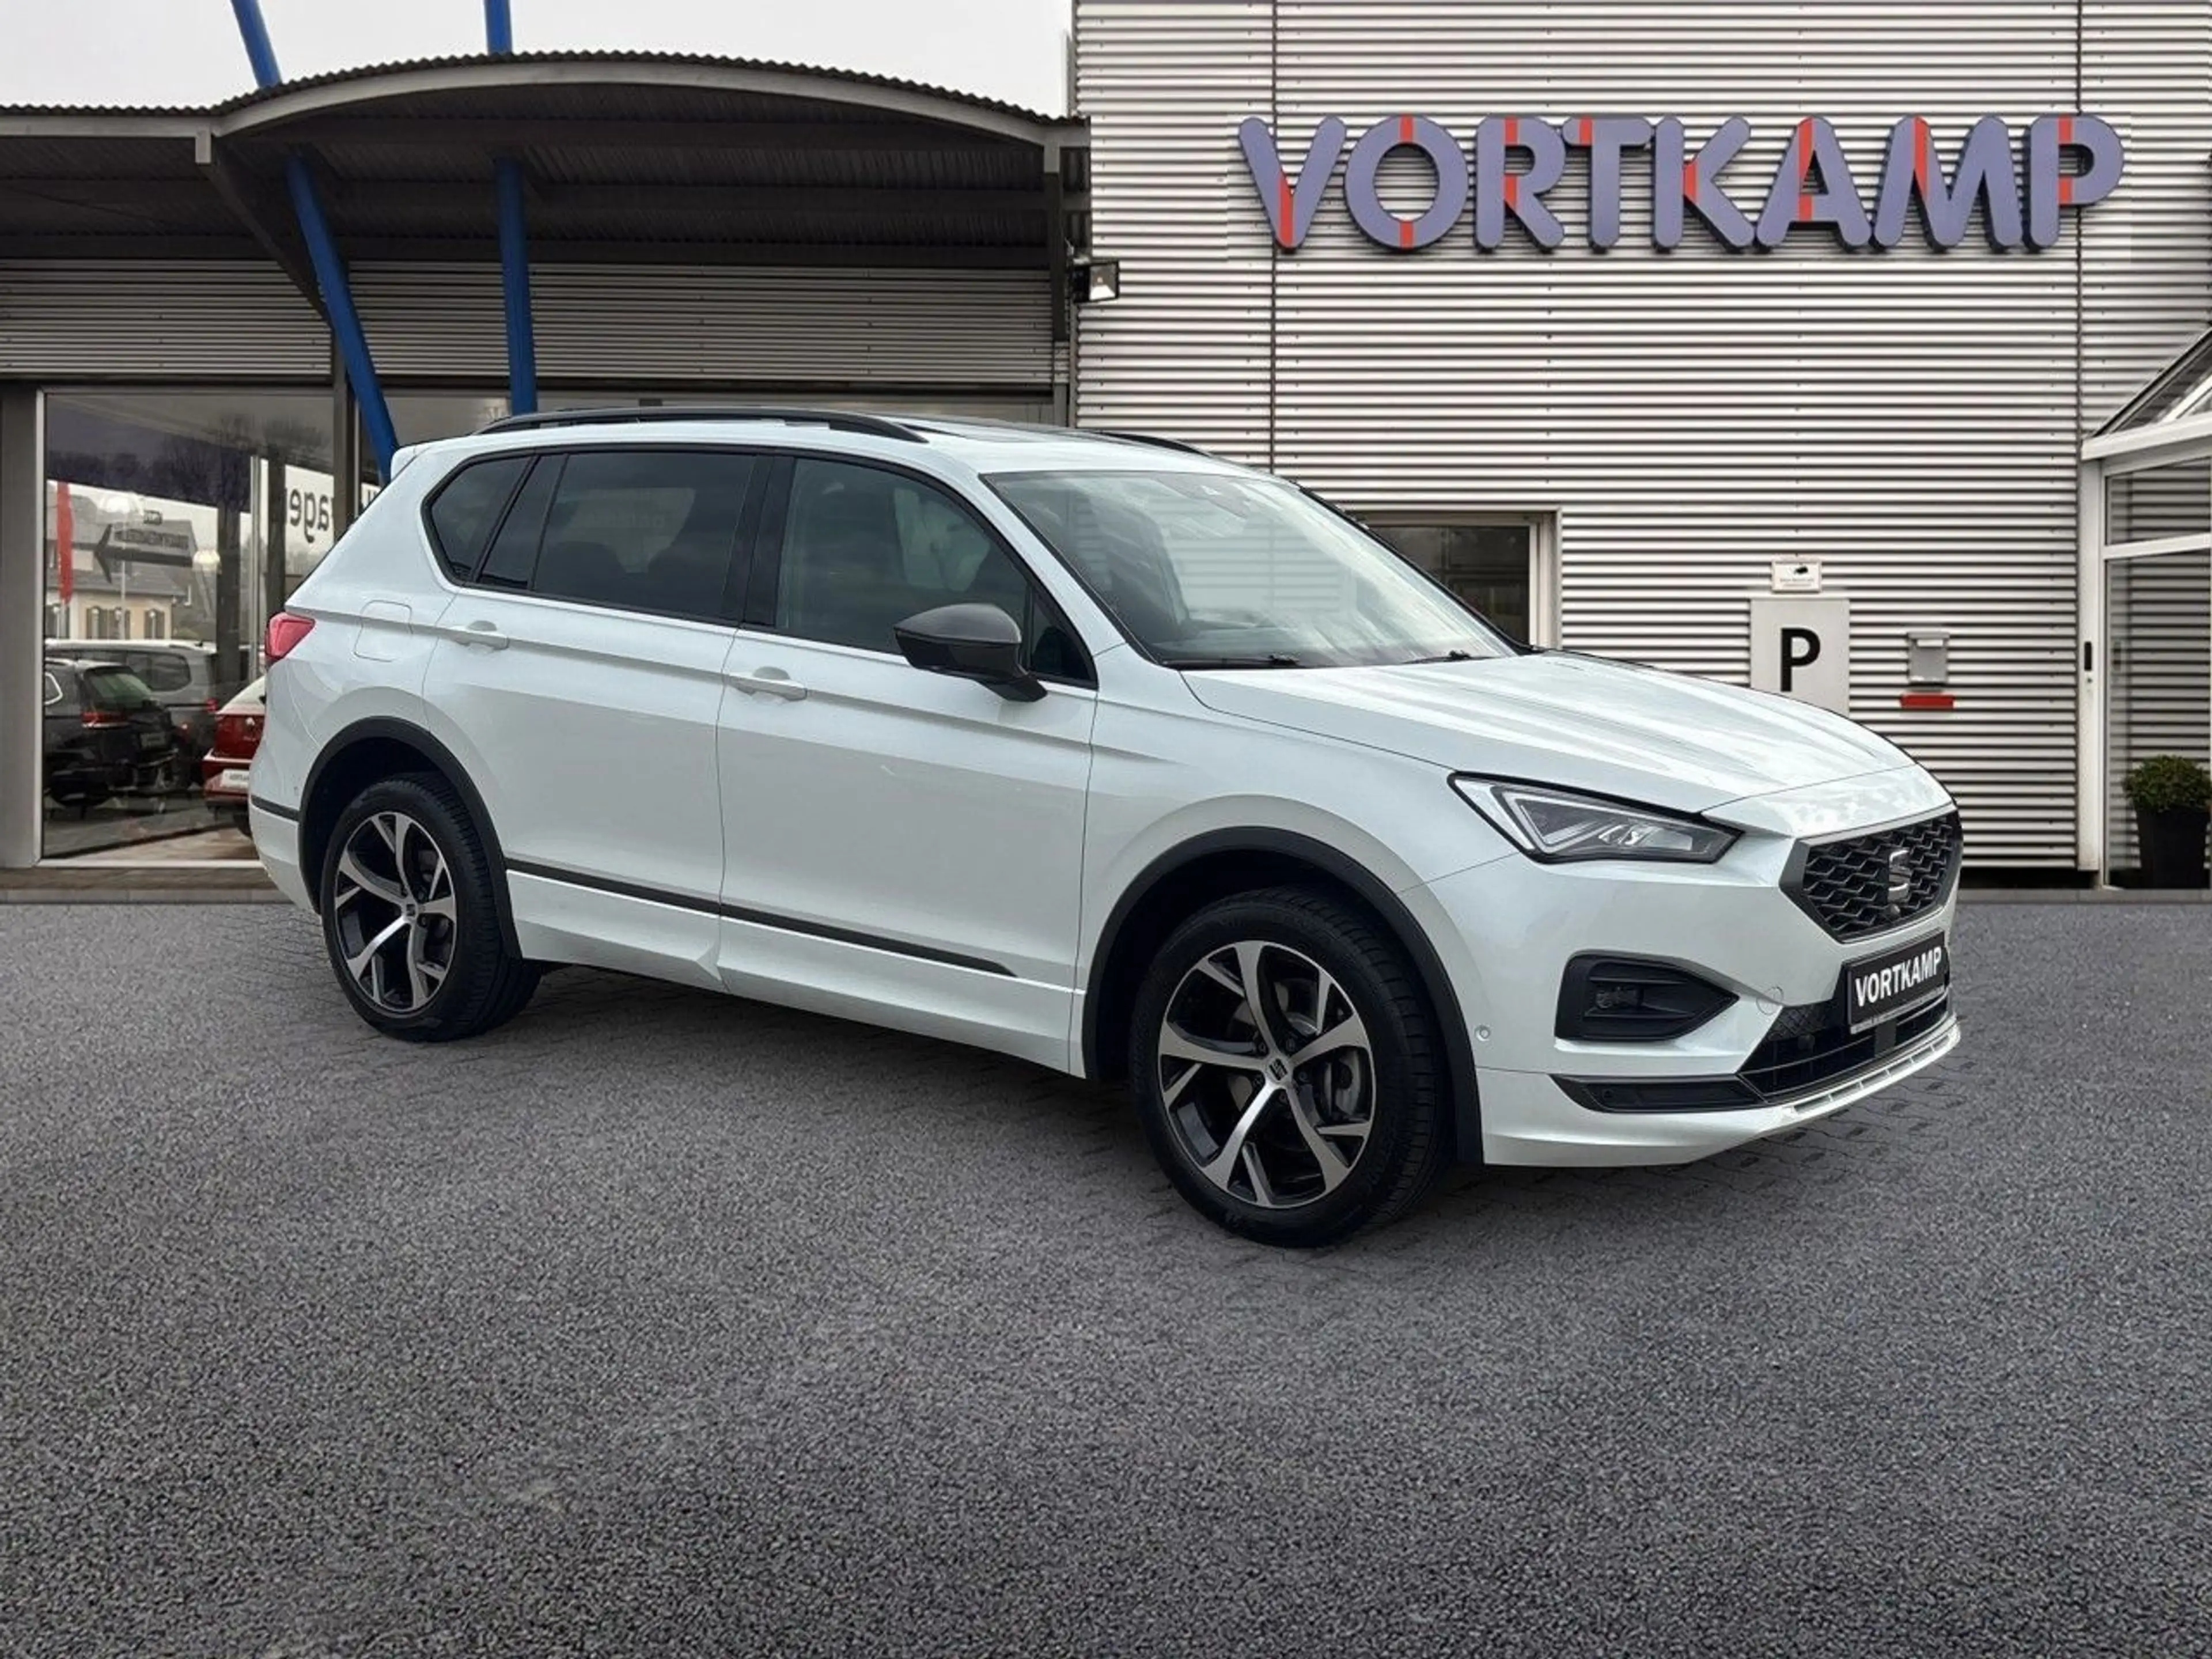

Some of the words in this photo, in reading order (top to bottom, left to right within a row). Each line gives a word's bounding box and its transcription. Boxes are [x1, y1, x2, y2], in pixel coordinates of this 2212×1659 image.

[1238, 113, 2124, 249] VORTKAMP
[1781, 627, 1820, 692] P
[1855, 946, 1942, 1007] VORTKAMP
